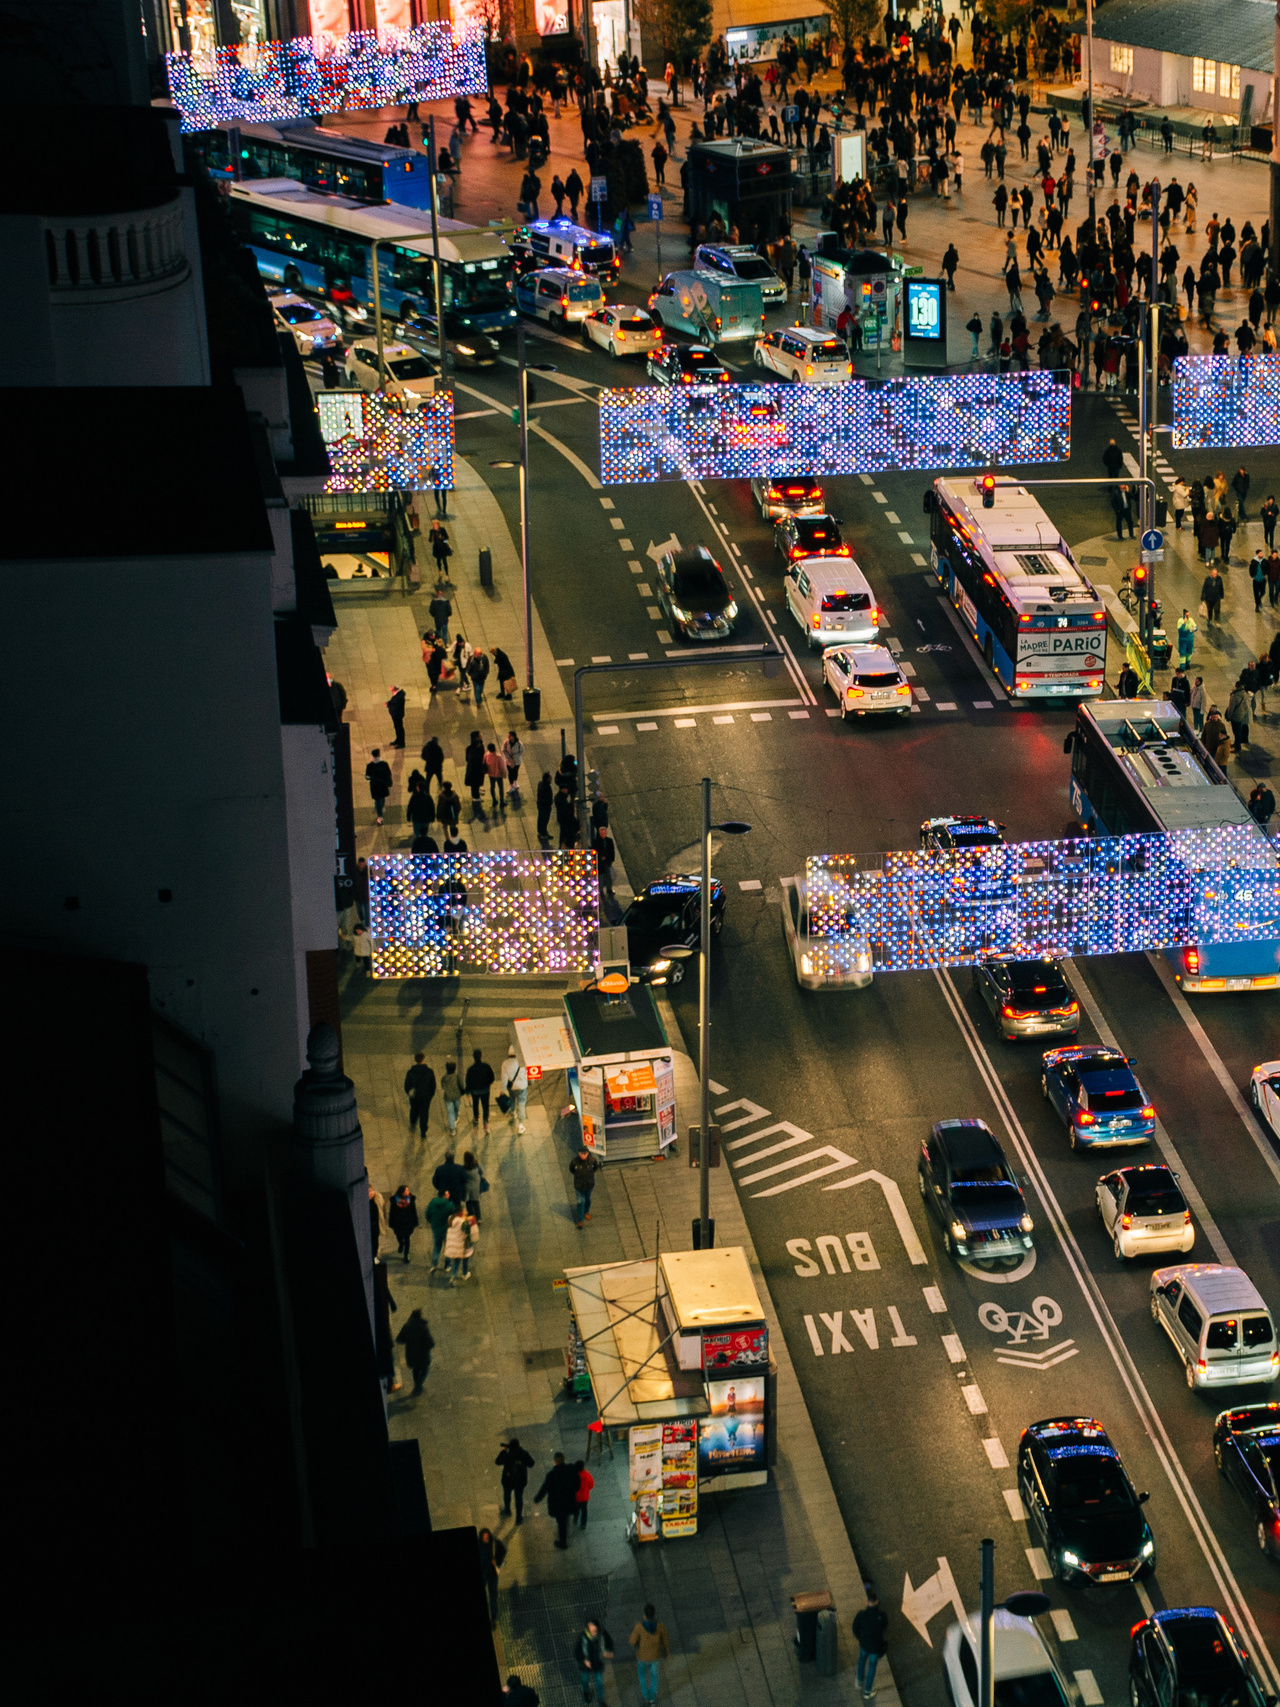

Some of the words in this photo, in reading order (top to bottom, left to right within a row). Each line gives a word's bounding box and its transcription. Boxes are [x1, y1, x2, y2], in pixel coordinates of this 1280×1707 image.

[910, 296, 938, 326] 130
[1020, 640, 1049, 652] MADRE
[1072, 780, 1083, 816] 75
[785, 1231, 881, 1277] BUS
[803, 1305, 918, 1356] TAXI
